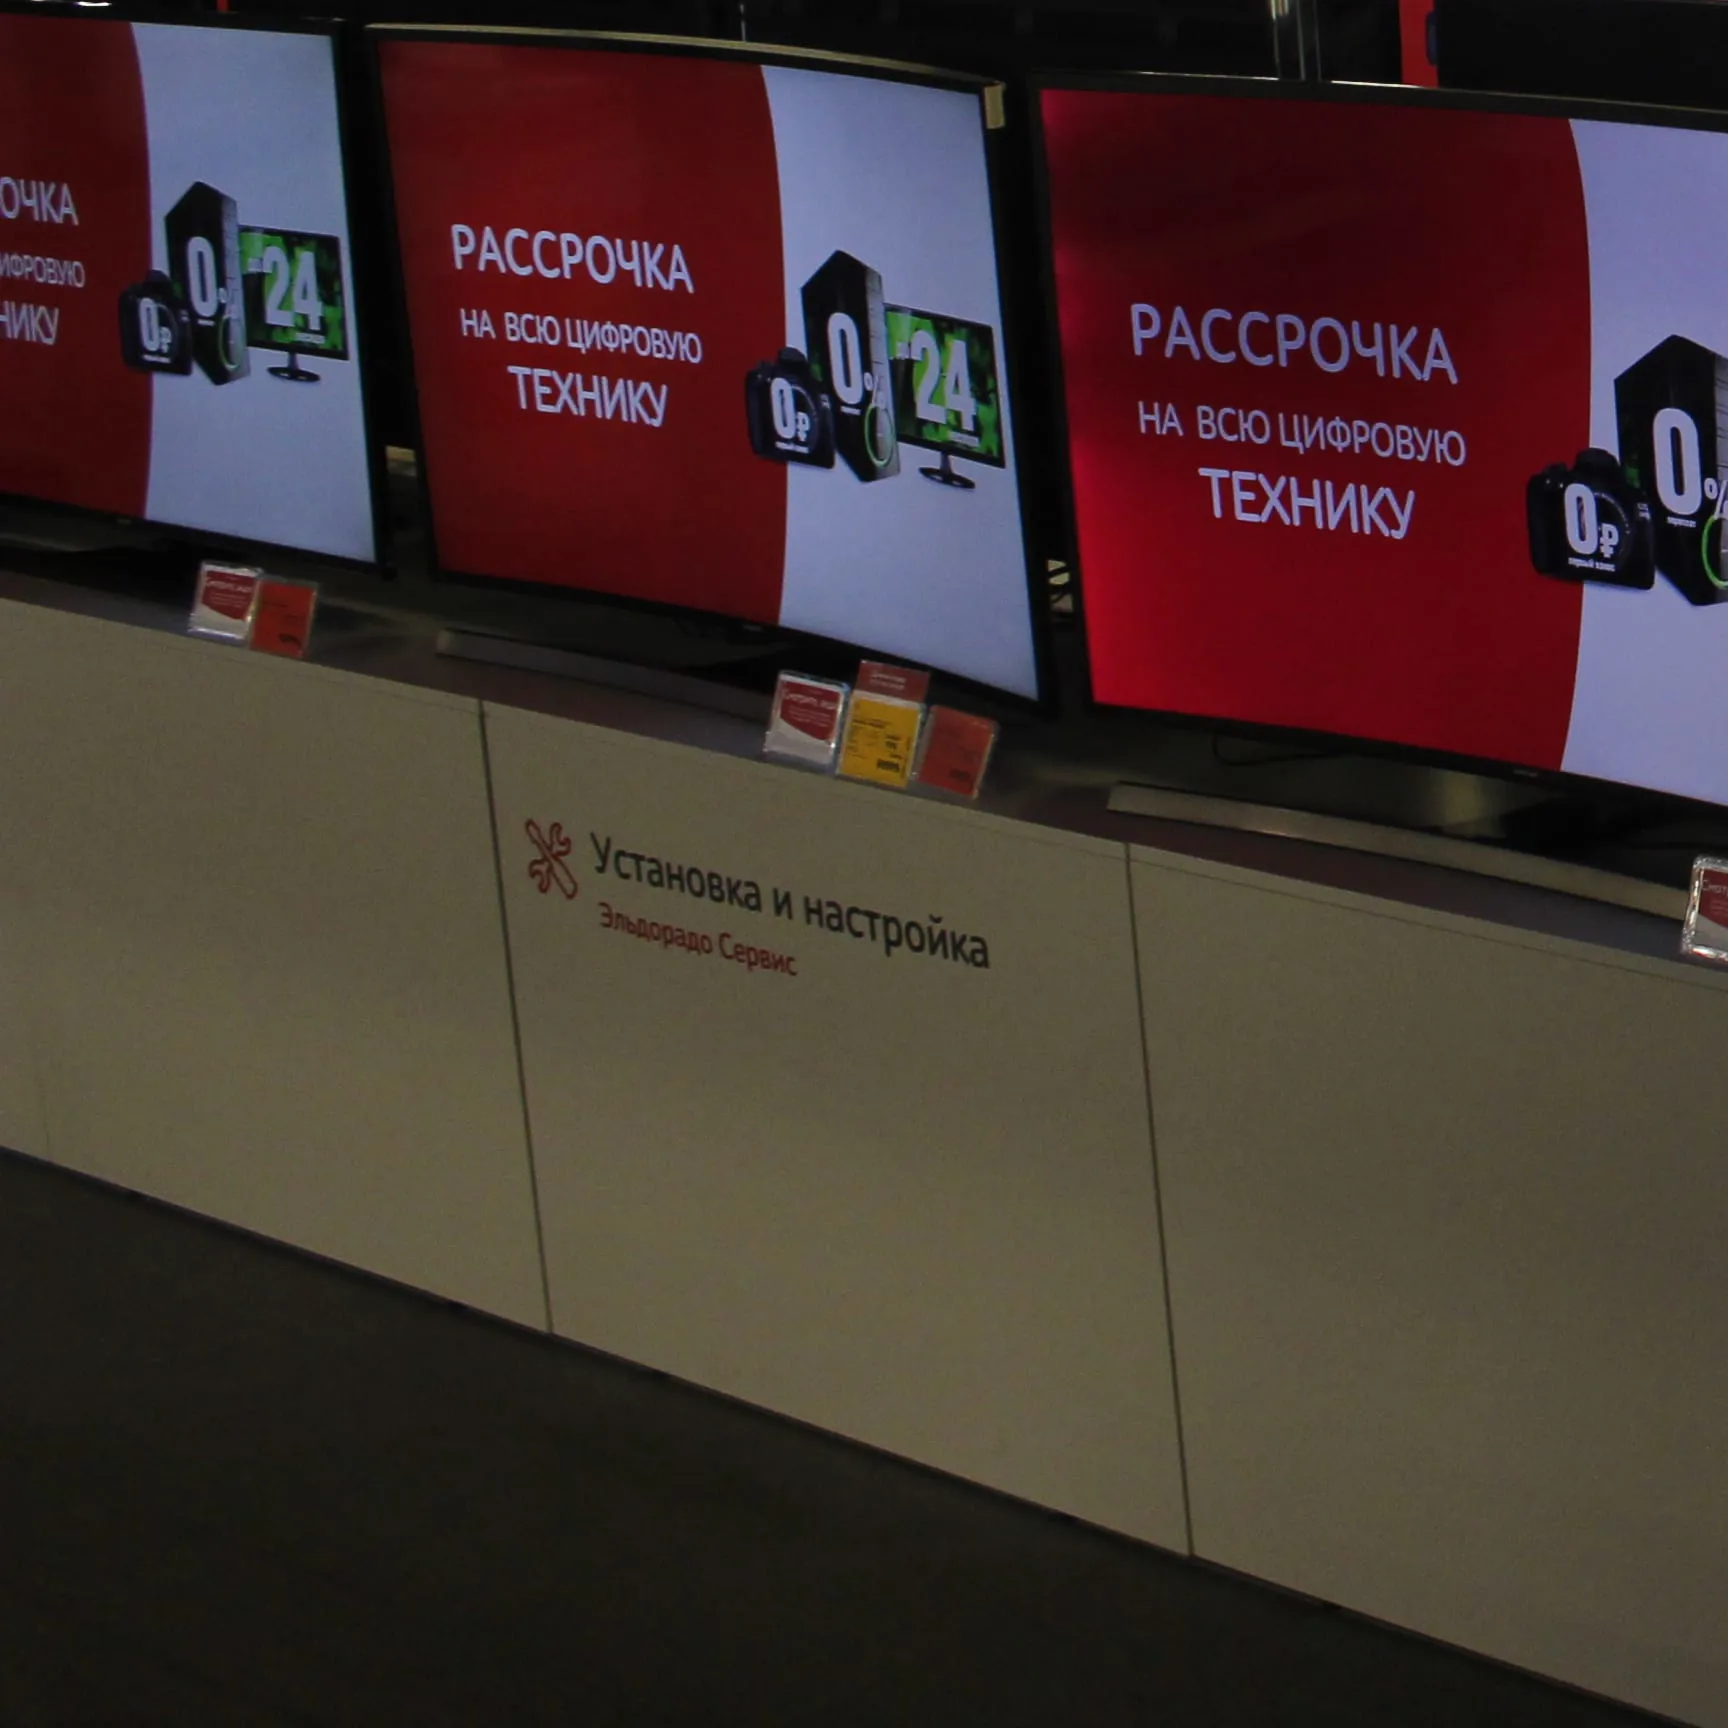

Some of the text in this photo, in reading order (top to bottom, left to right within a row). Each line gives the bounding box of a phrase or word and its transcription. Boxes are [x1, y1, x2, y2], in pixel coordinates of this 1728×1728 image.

[264, 245, 324, 331] 24
[450, 223, 695, 294] РАССРОЧКА
[459, 308, 702, 365] НА ВСЮ ЦИФРОВУЮ
[1129, 302, 1459, 386] РАССРОЧКА
[506, 365, 668, 428] ТЕХНИКУ
[914, 329, 978, 432] 24
[1137, 400, 1467, 468] НА ВСЮ ЦИФРОВУЮ
[1198, 466, 1415, 541] ТЕХНИКУ
[589, 830, 990, 969] Установка и настройка
[598, 902, 797, 976] Эльдорадо Сервис
